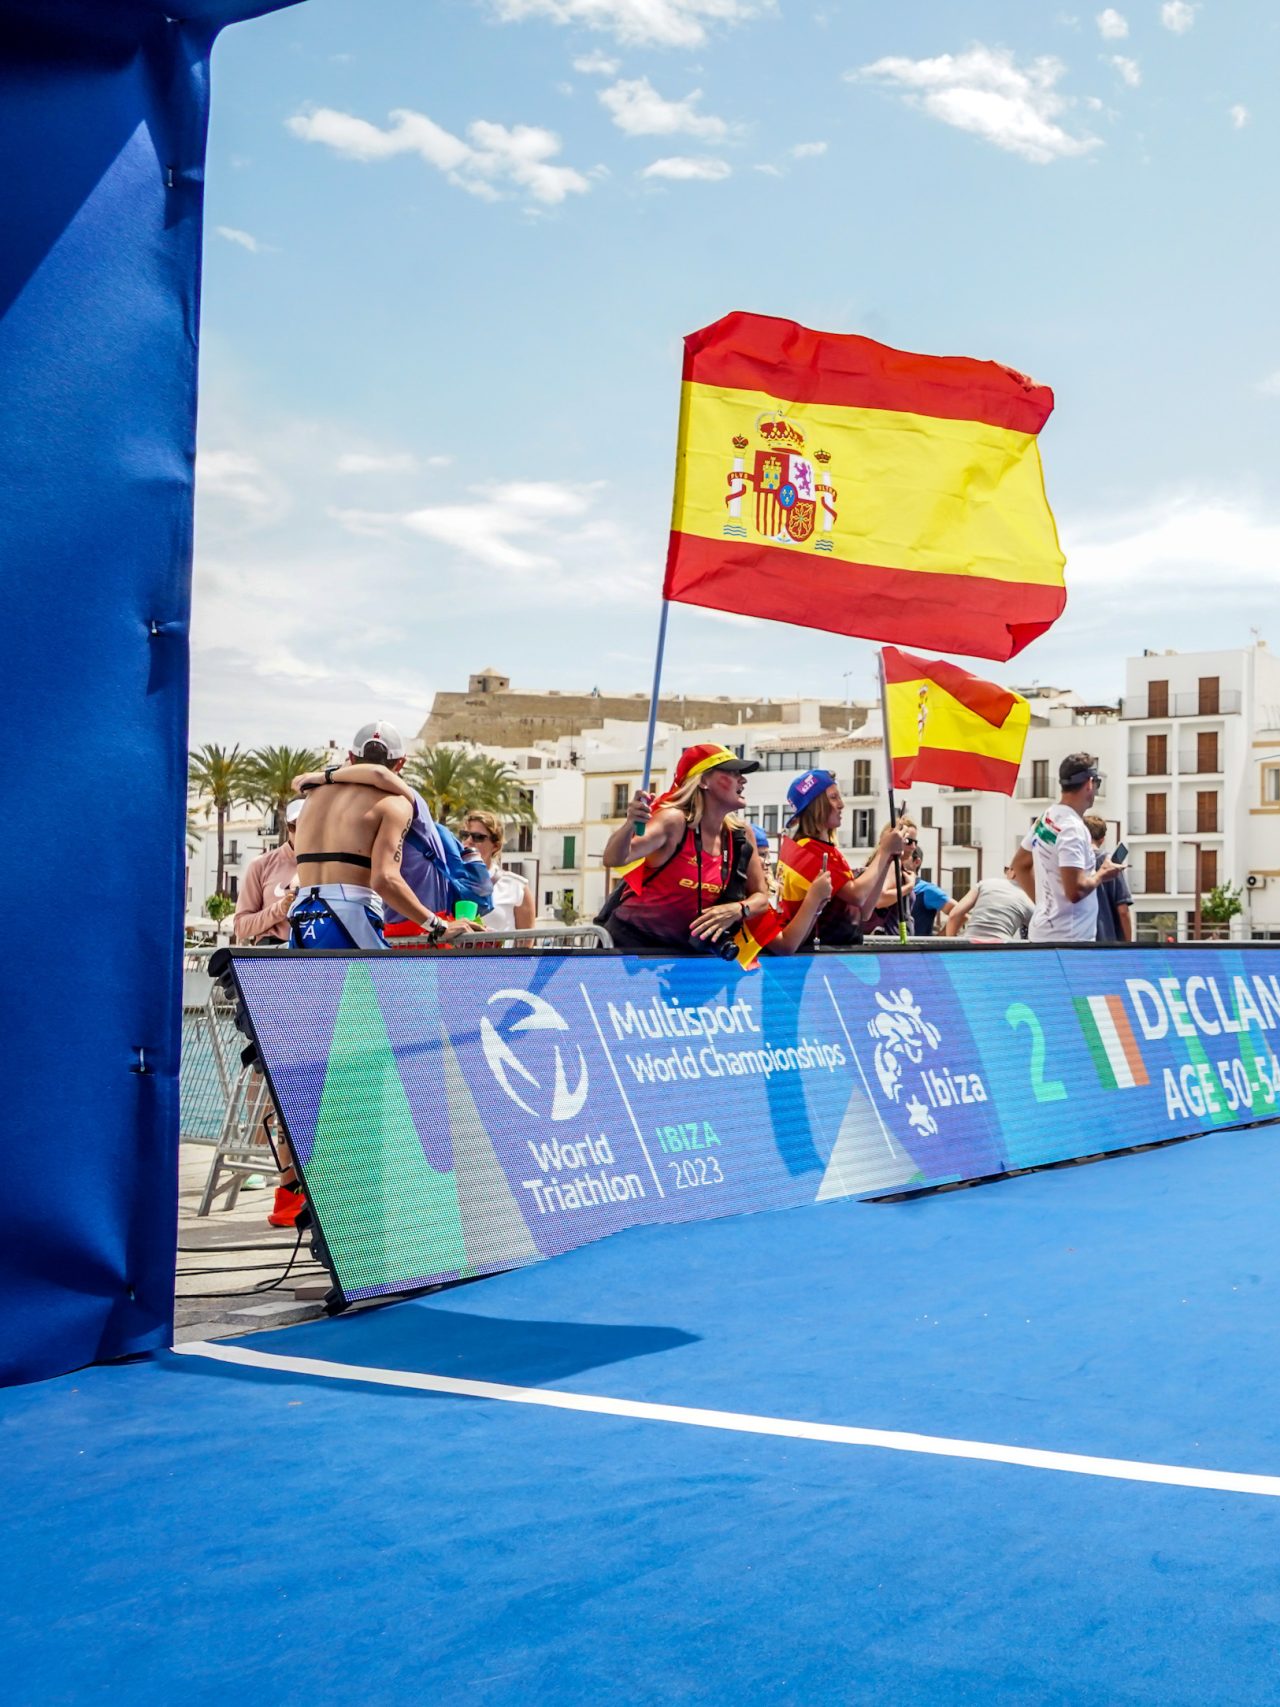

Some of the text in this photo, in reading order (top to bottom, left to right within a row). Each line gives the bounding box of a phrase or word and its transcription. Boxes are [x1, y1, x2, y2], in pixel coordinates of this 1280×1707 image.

[608, 997, 760, 1045] Multisport
[626, 1039, 846, 1084] World Championships
[1006, 1002, 1068, 1103] 2
[921, 1066, 988, 1109] Ibiza
[1162, 1062, 1223, 1121] AGE
[527, 1133, 614, 1174] World
[655, 1120, 721, 1154] IBIZA
[523, 1169, 646, 1214] Triathlon
[668, 1156, 725, 1190] 2023
